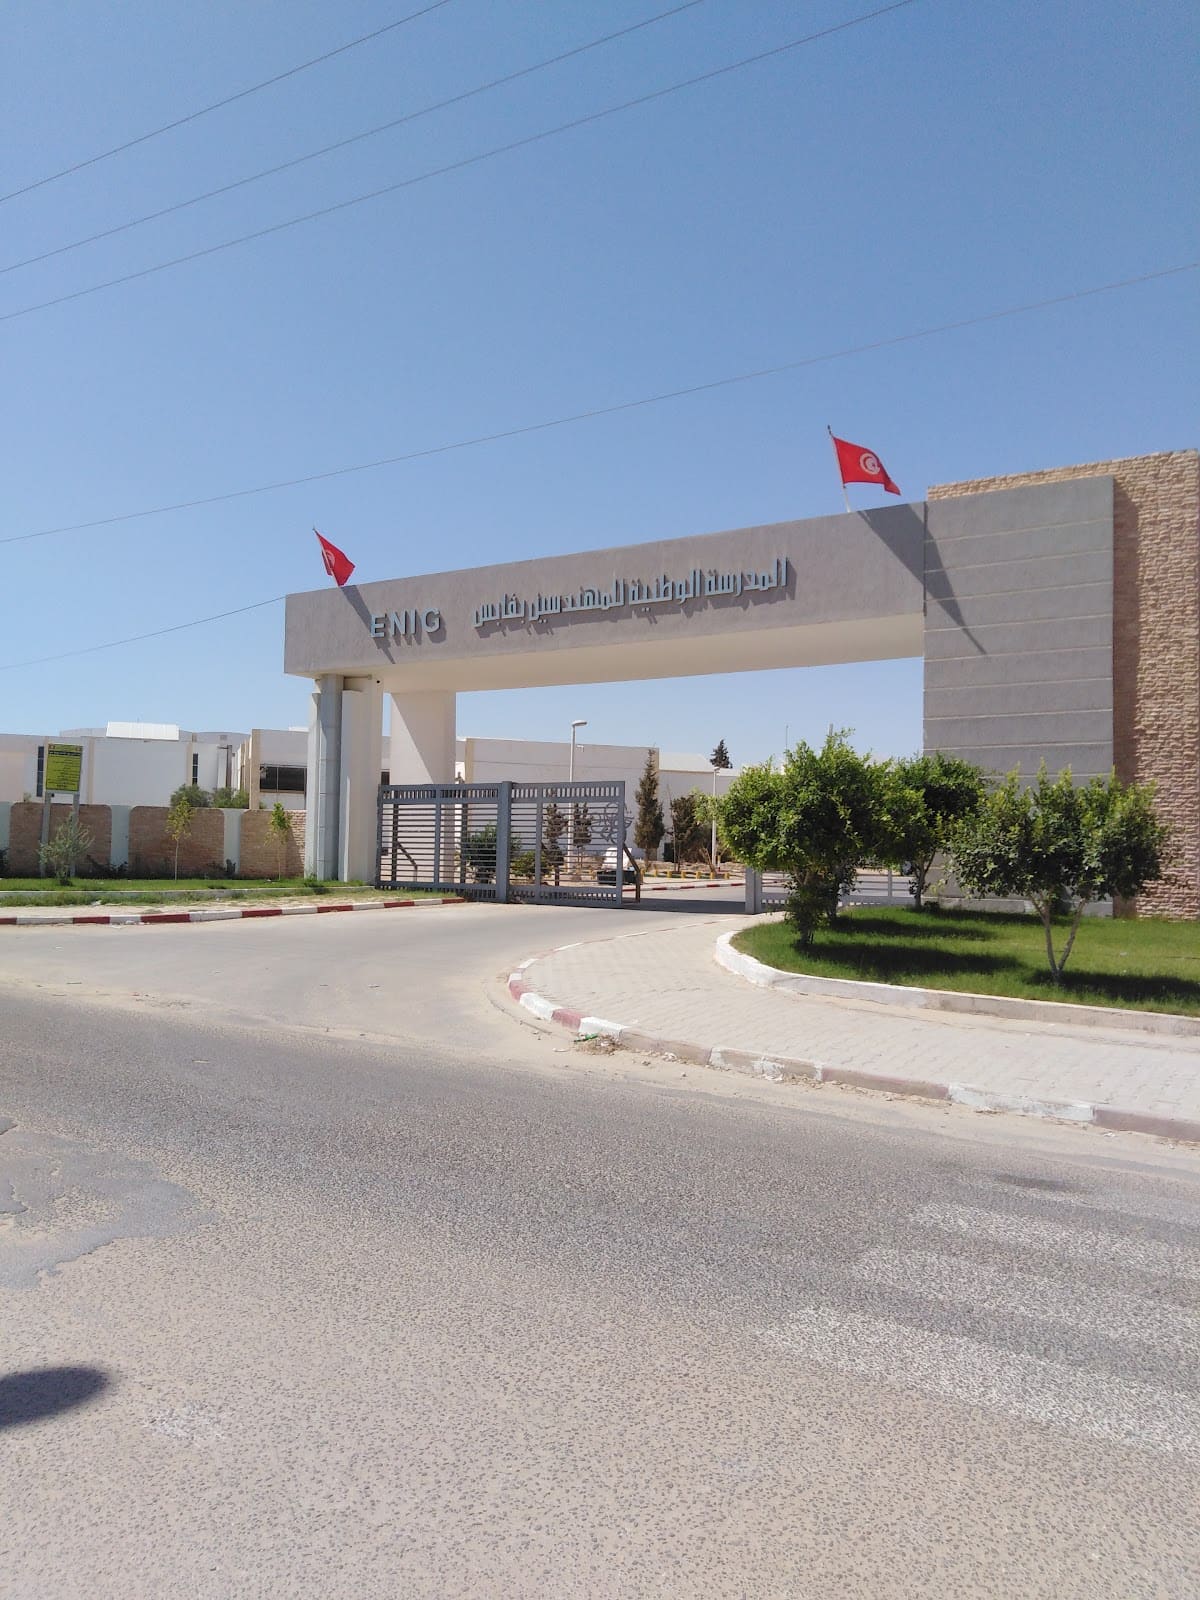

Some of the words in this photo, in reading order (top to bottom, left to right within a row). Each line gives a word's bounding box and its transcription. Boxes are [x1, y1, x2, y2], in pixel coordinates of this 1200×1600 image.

[628, 568, 701, 612] الوطنية
[704, 554, 788, 597] المدرسة
[473, 592, 526, 628] بقابس
[528, 576, 625, 624] للمهندسين
[370, 607, 440, 638] ENIG
